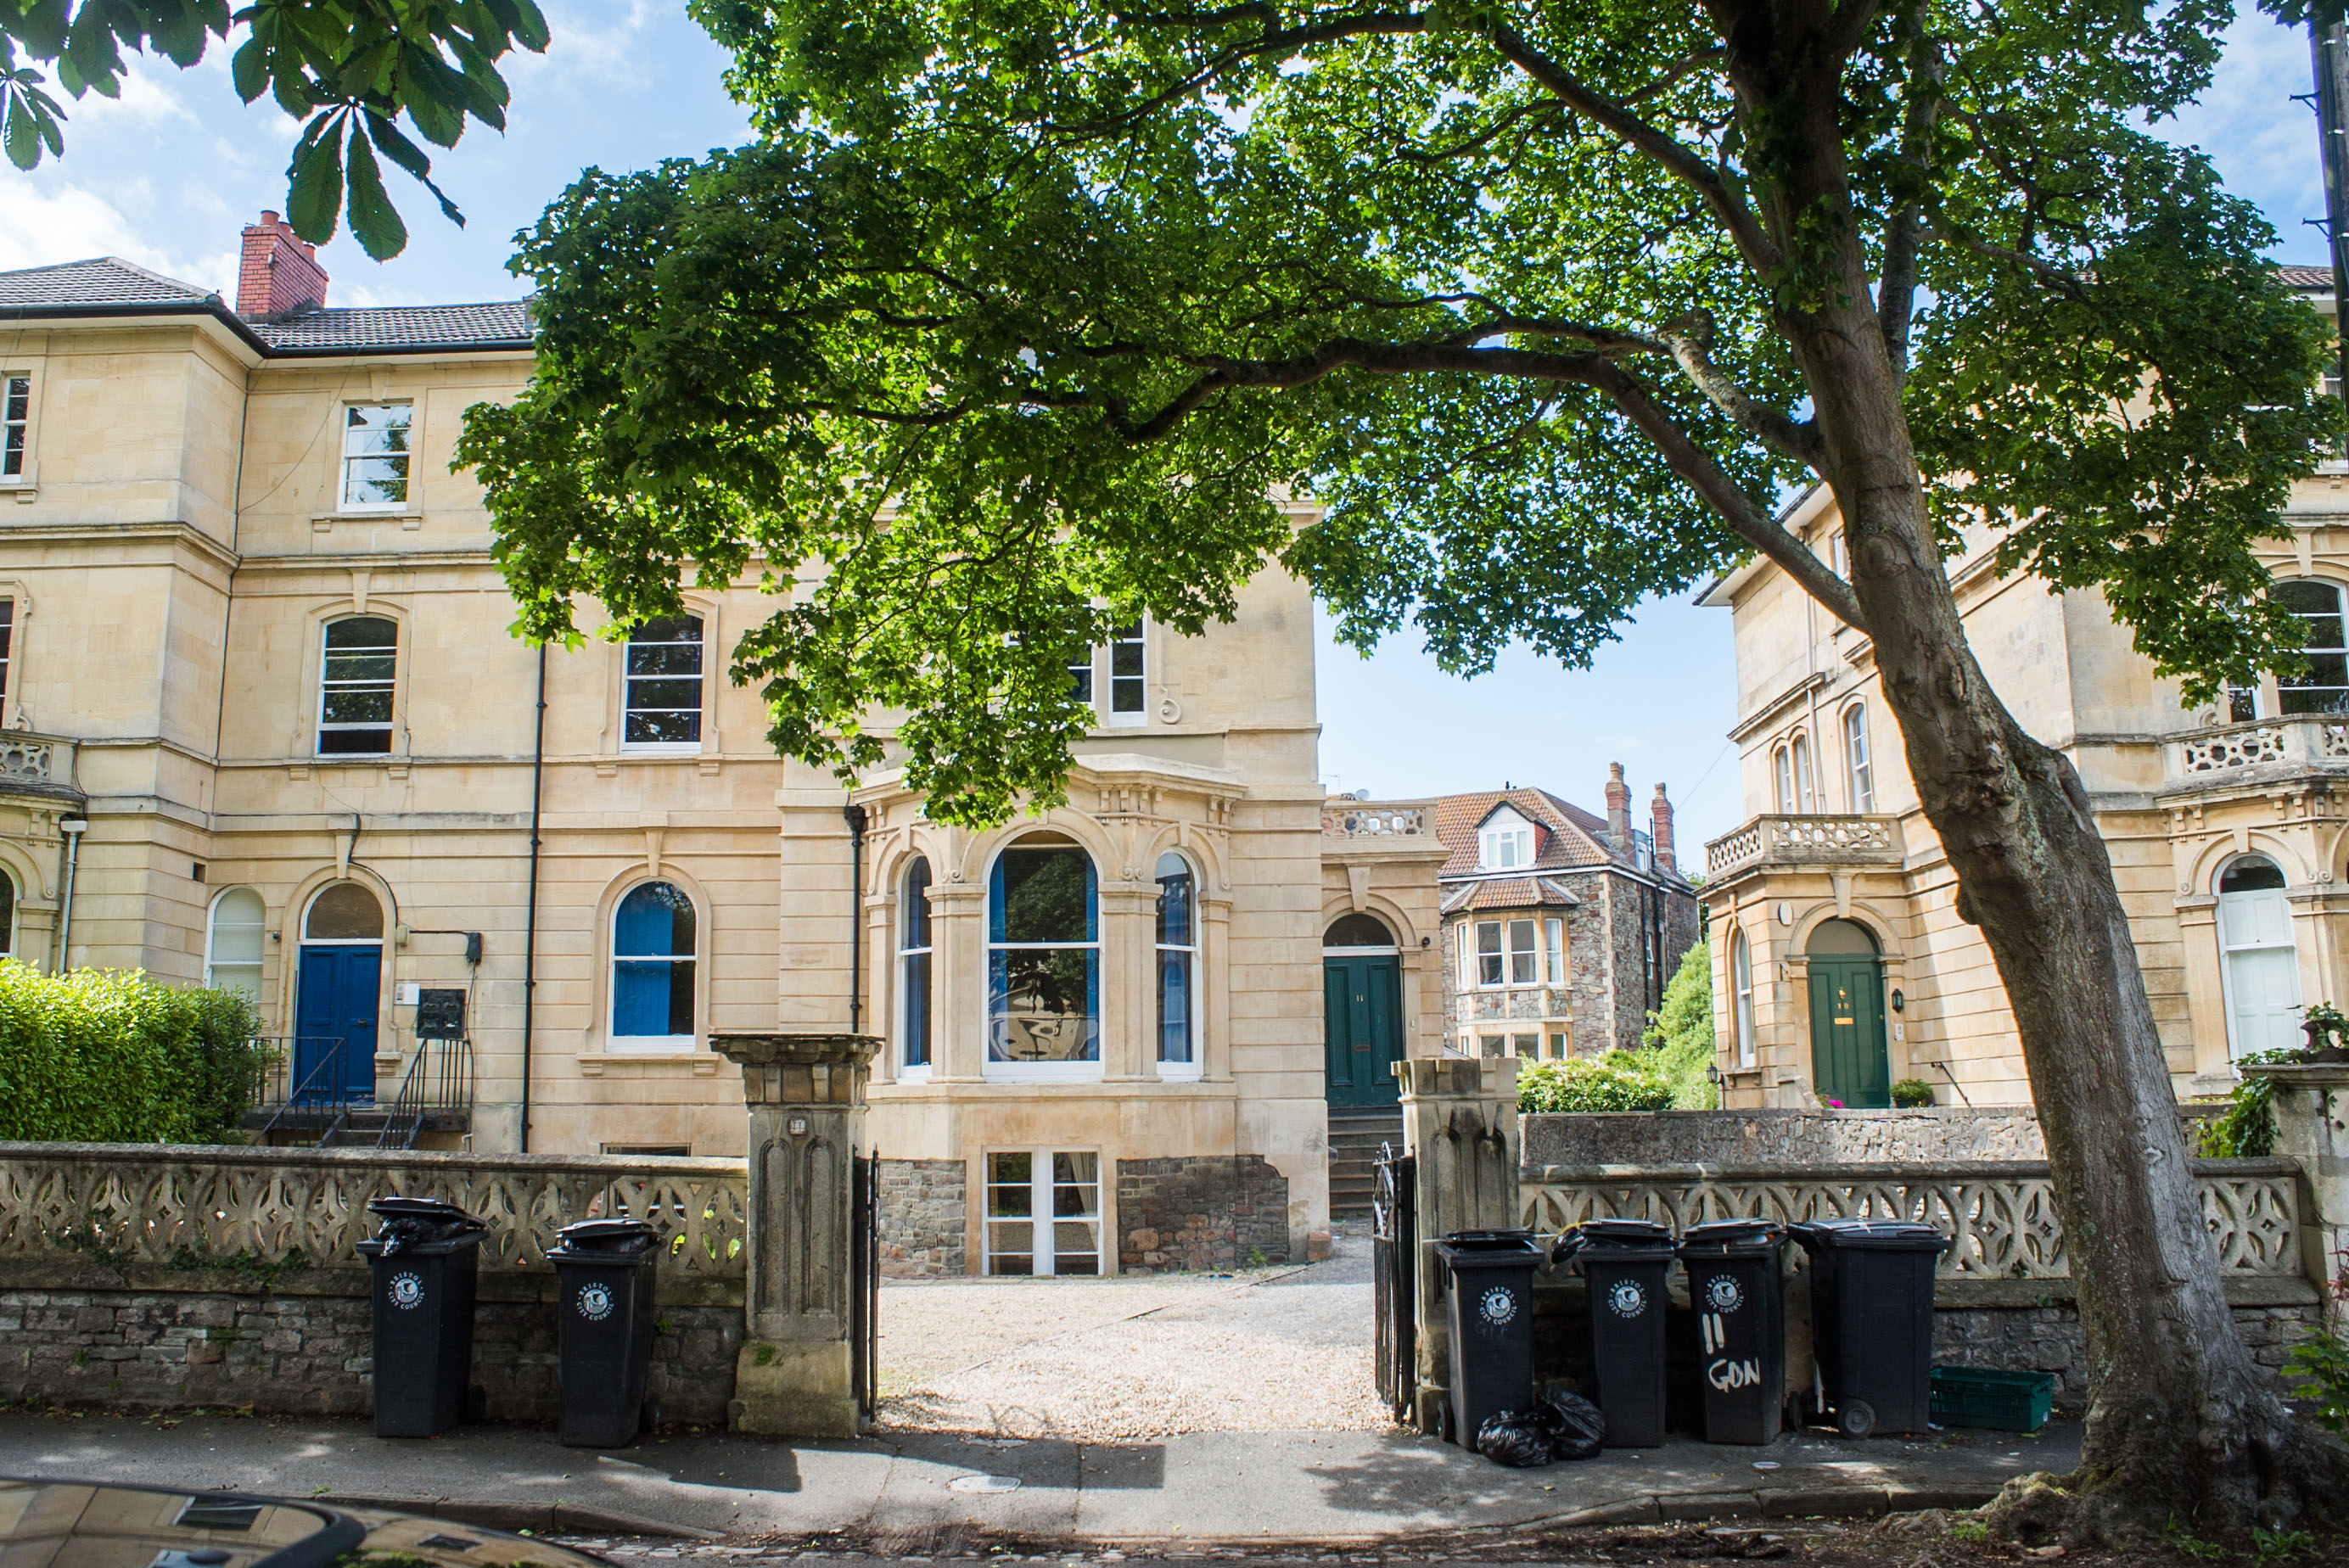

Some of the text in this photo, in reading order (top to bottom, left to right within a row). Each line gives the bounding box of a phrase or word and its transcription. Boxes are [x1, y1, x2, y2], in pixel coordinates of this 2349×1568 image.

[390, 1271, 423, 1285] BRISTOL
[1610, 1279, 1645, 1293] BRISTOL
[1707, 1274, 1741, 1289] BRISTOL
[578, 1282, 612, 1296] BRISTOL
[1481, 1285, 1515, 1301] BRISTOL
[388, 1291, 425, 1310] CITY COUNCIL
[1608, 1299, 1647, 1319] CITY COUNCIL
[1705, 1294, 1745, 1313] CITY COUNCIL
[576, 1302, 614, 1321] CITY COUNCIL
[1479, 1305, 1517, 1324] CITY COUNCIL
[1702, 1313, 1724, 1355] 11
